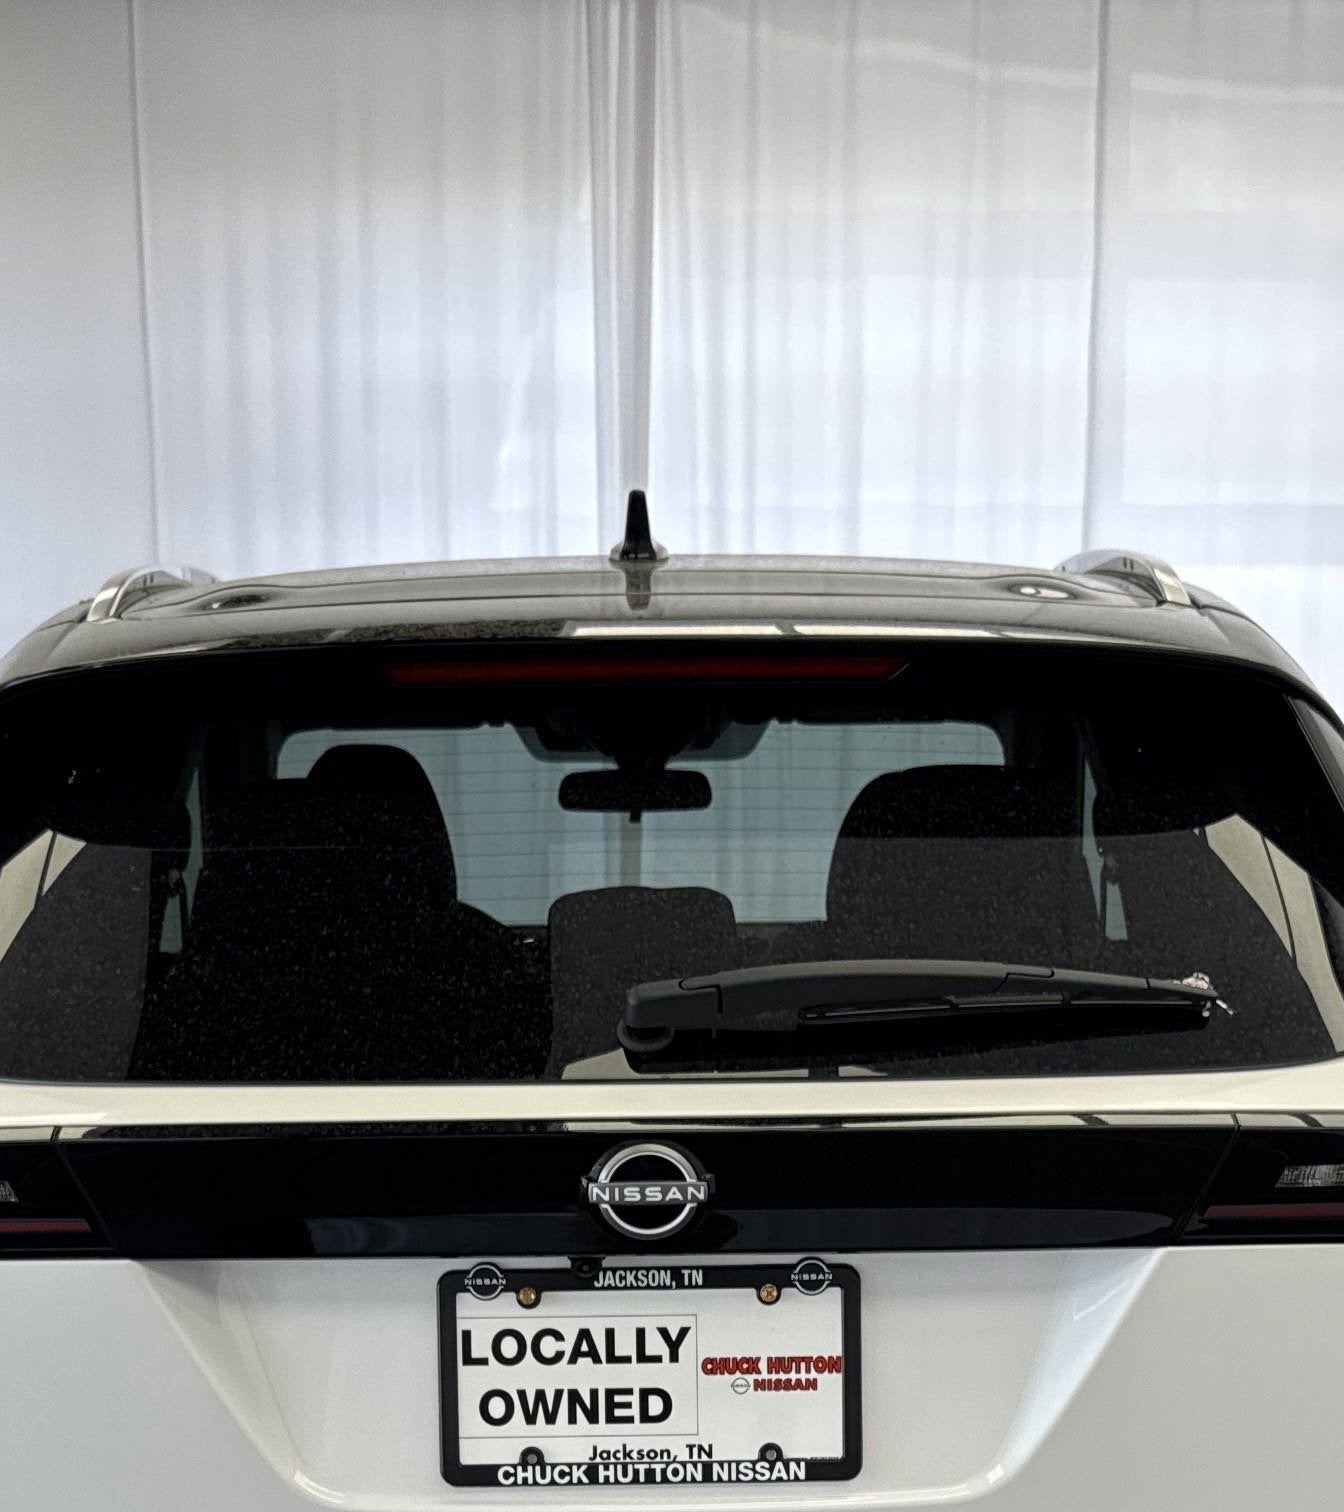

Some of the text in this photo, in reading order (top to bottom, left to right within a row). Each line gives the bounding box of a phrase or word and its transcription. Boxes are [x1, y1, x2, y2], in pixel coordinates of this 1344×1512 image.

[592, 1186, 705, 1202] NISSAN
[464, 1278, 507, 1286] NISSAN
[593, 1269, 704, 1290] JACKSON, TN
[790, 1273, 833, 1281] NISSAN
[461, 1326, 692, 1367] LOCALLY
[701, 1355, 843, 1375] CHUCK HUTTON
[753, 1378, 818, 1392] NISSAN
[478, 1387, 673, 1427] OWNED
[588, 1443, 714, 1462] Jackson, TN
[497, 1461, 806, 1486] CHUCK HUTTON NISSAN
